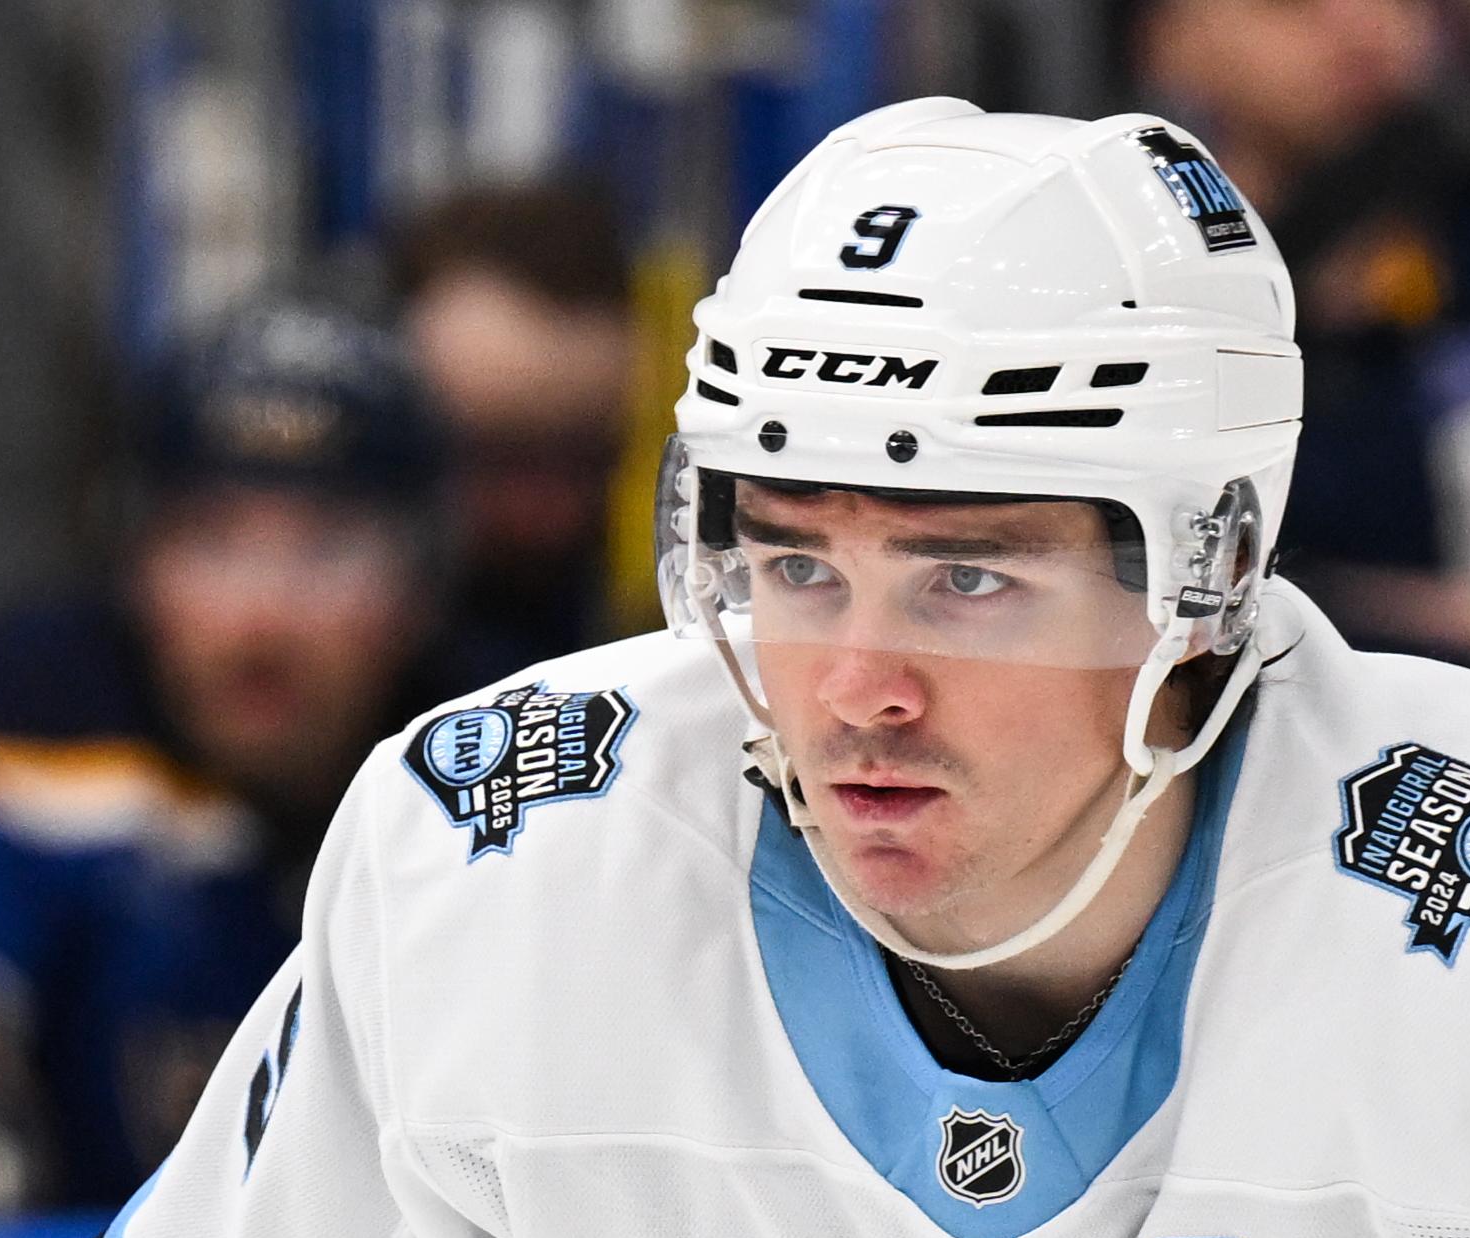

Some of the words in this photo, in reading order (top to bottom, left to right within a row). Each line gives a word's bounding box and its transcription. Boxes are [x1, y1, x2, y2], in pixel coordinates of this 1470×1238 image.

[838, 205, 923, 271] 9
[761, 347, 939, 390] CCM
[454, 716, 484, 774] UTAH
[516, 694, 571, 798] SEASON
[490, 775, 512, 829] 2025
[1359, 755, 1447, 874] INAUGURAL
[1420, 871, 1460, 926] 2024
[956, 1135, 1007, 1182] NHL
